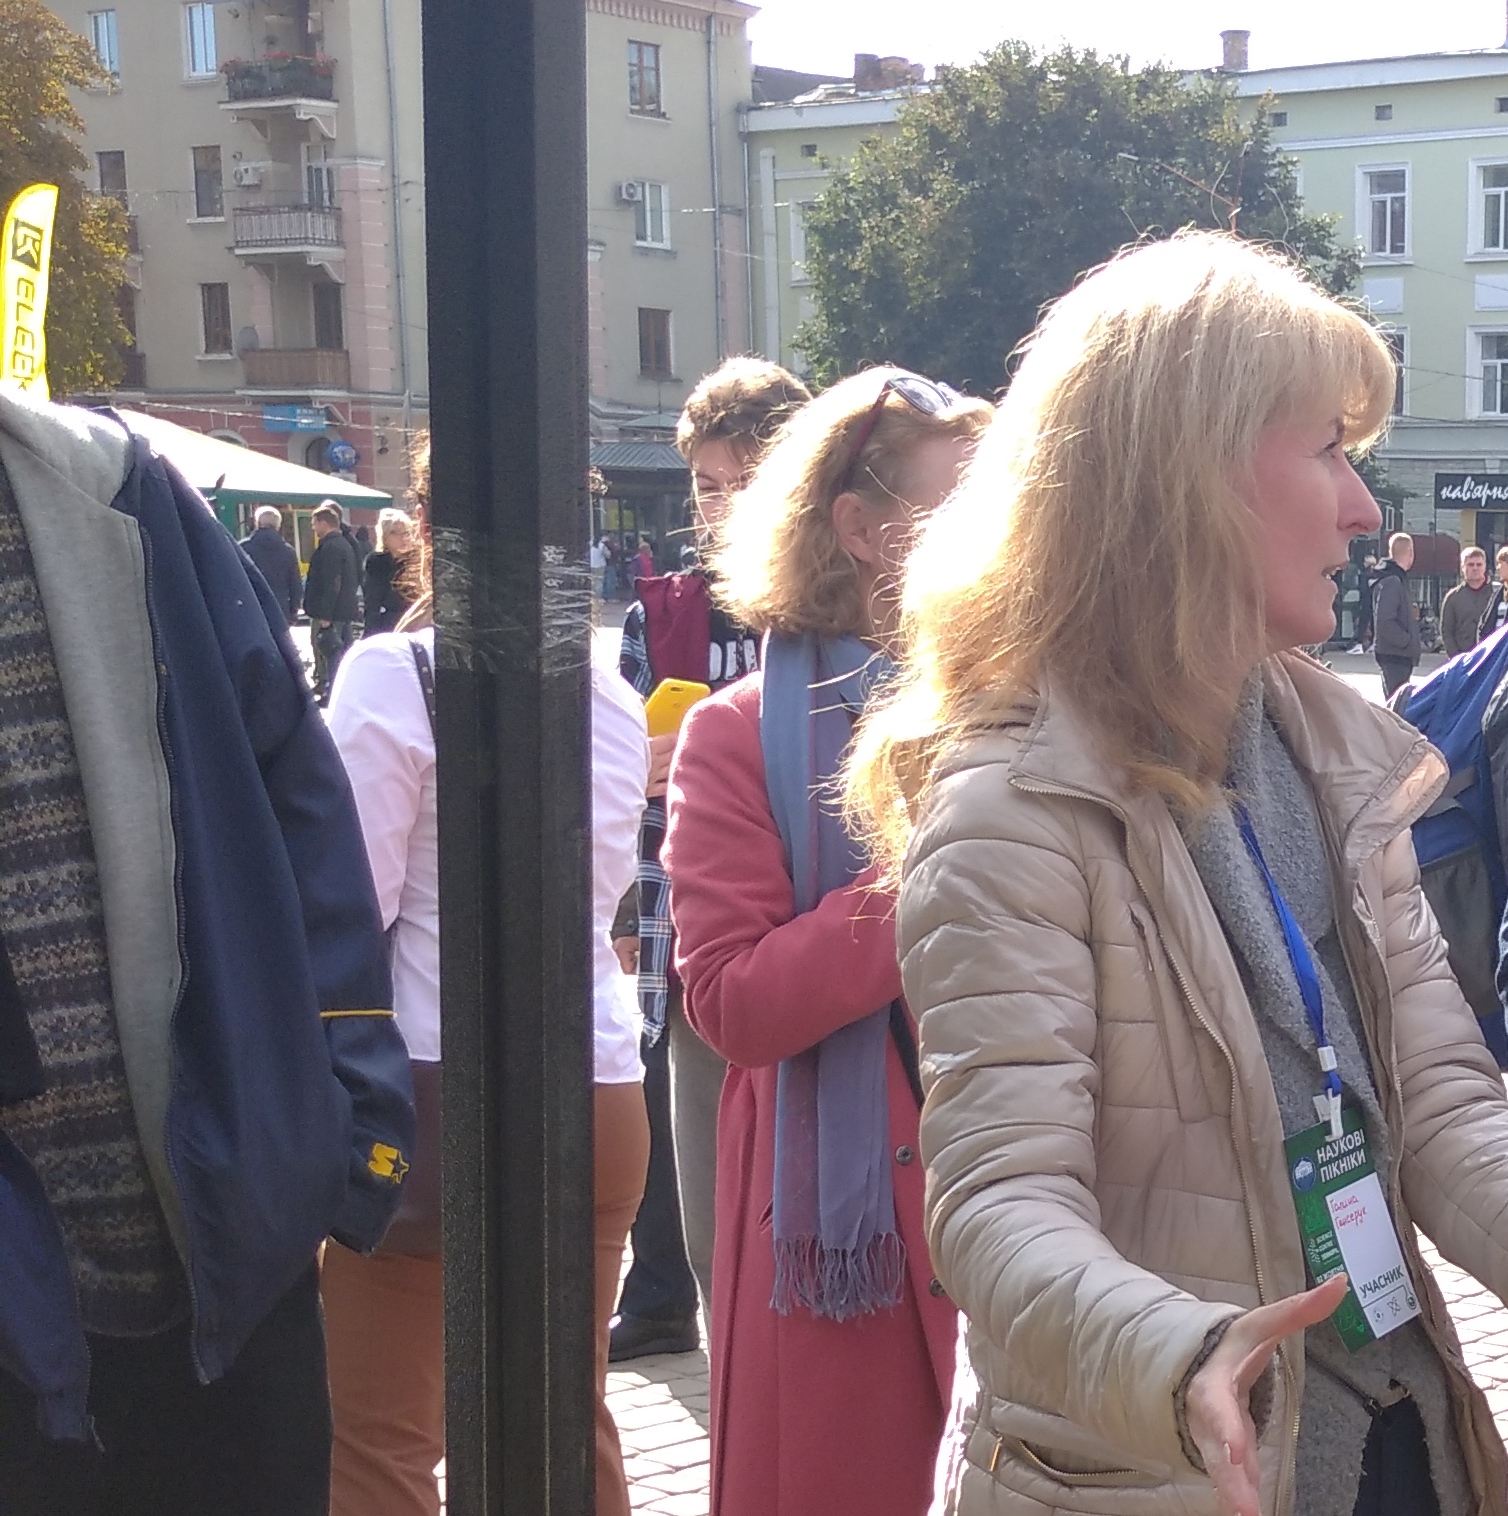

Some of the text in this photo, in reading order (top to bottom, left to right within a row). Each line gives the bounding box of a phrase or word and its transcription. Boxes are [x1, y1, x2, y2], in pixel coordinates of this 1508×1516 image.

[1316, 1128, 1365, 1164] НАУКОВІ
[1320, 1148, 1366, 1183] ПІКНІКИ
[1359, 1265, 1404, 1298] УЧАСНИК
